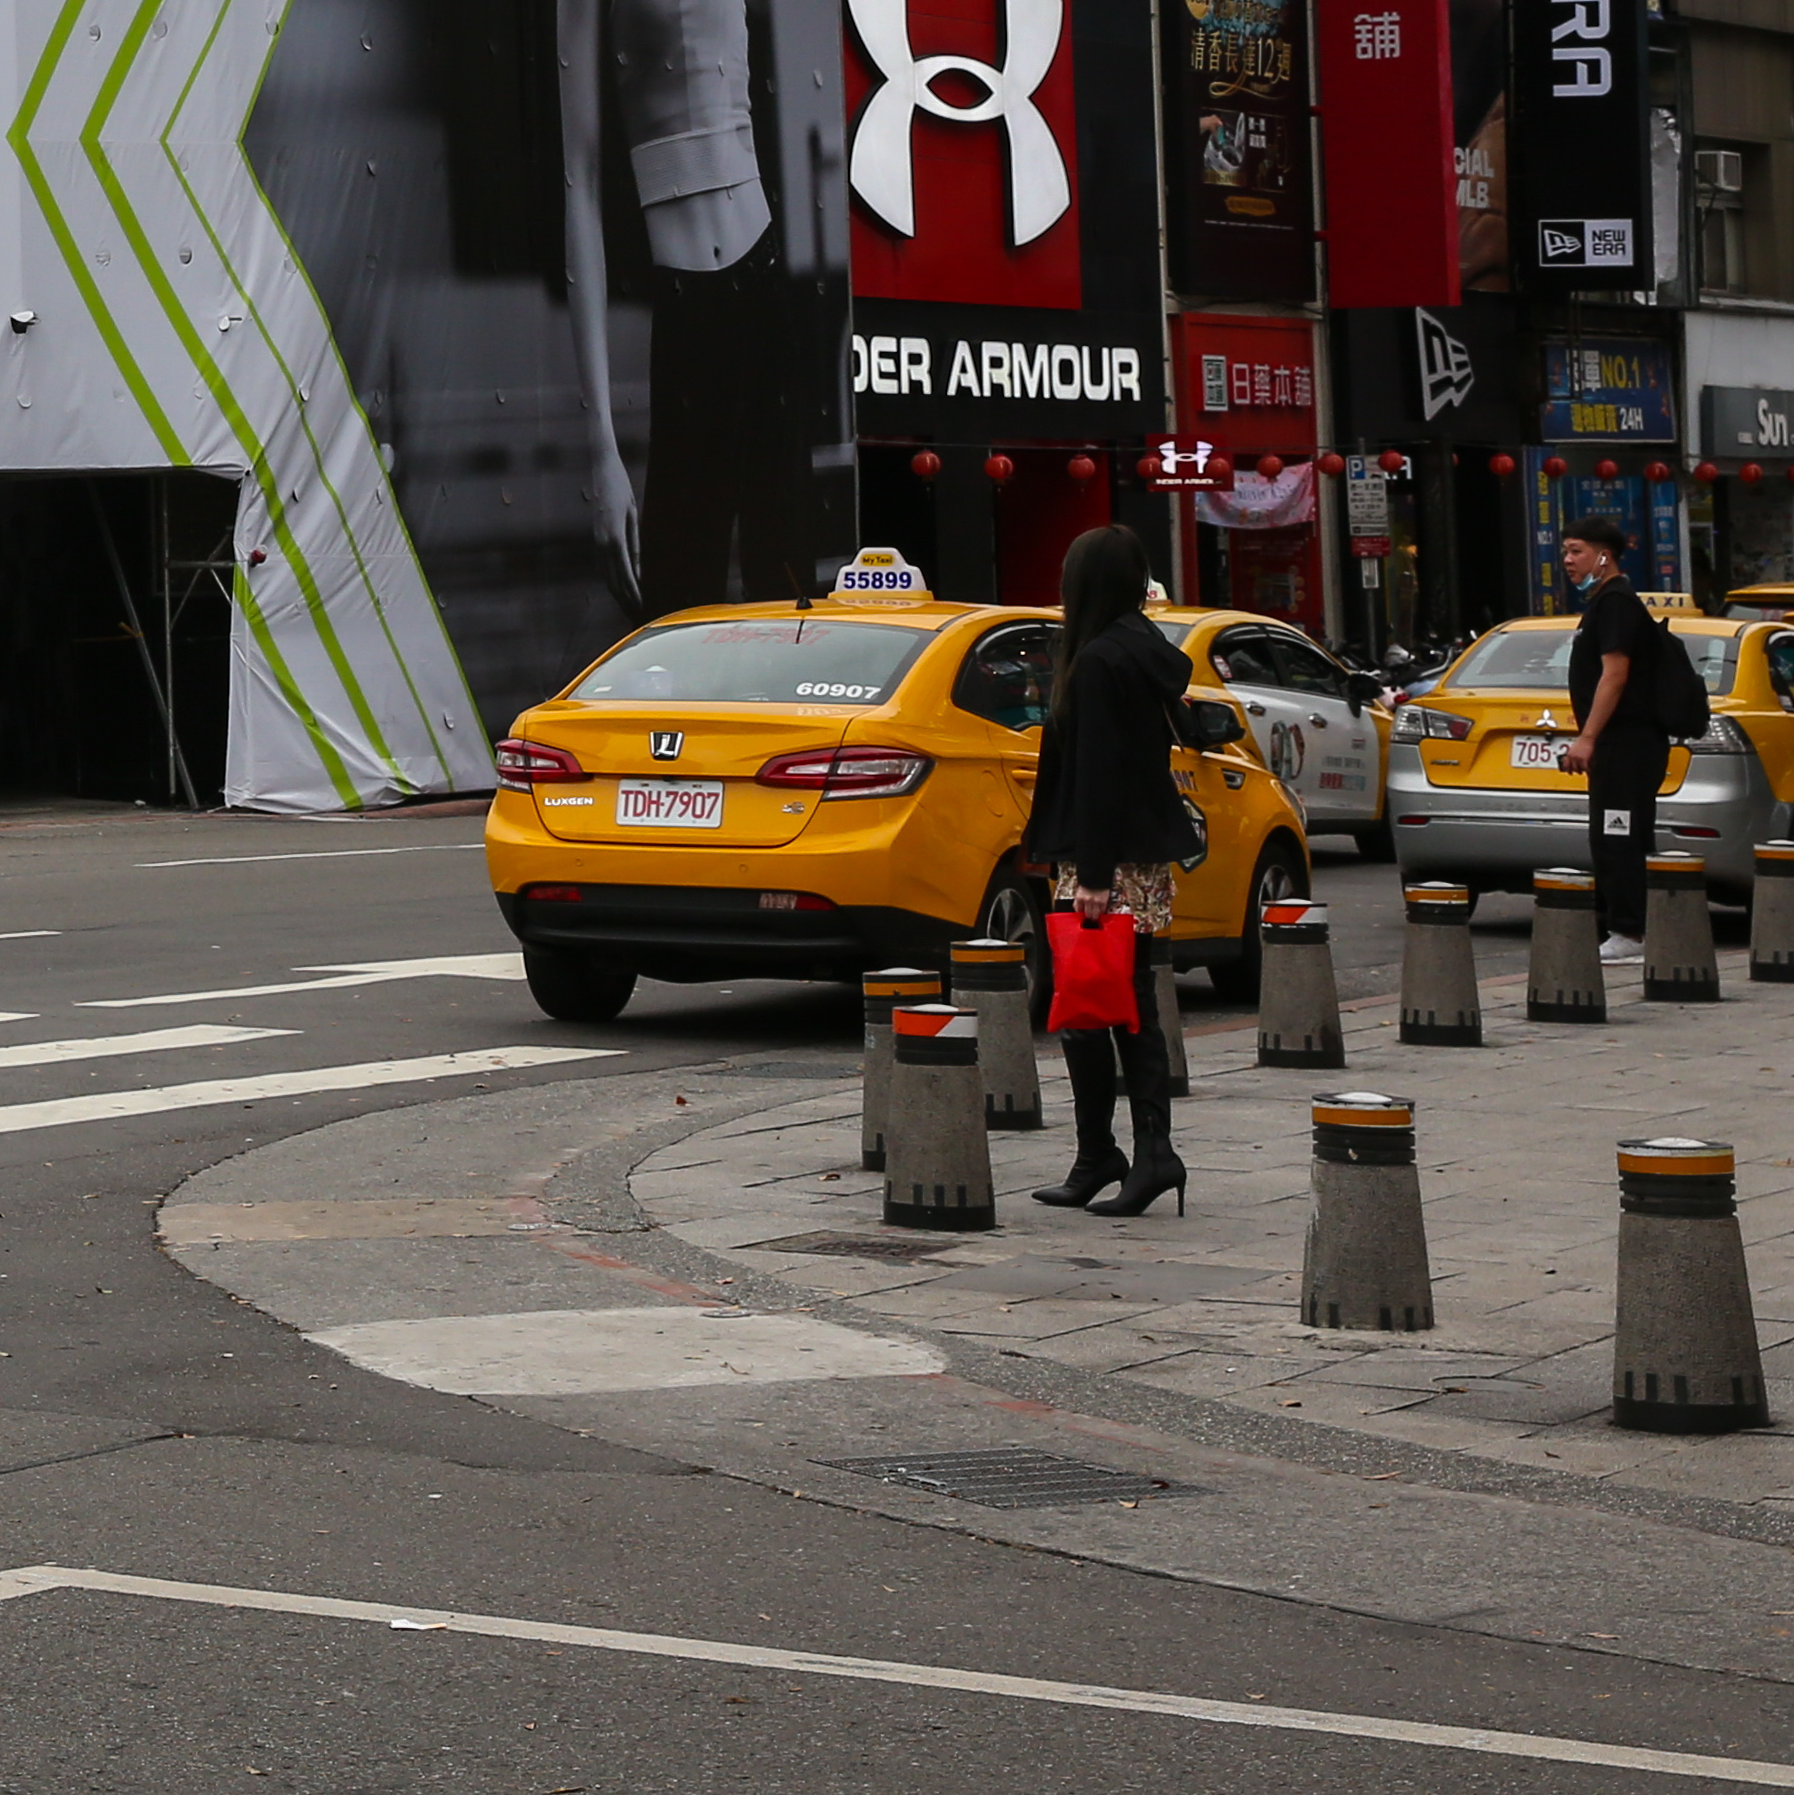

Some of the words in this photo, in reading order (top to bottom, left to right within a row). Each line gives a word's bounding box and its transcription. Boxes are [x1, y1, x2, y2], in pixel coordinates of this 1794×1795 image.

[1592, 229, 1626, 242] NEW
[1592, 242, 1626, 256] ERA
[947, 340, 1141, 401] ARMOUR
[1602, 356, 1640, 389] NO.1
[1619, 407, 1644, 430] 24H
[843, 571, 912, 589] 55899
[1645, 597, 1684, 607] AXI
[795, 682, 881, 700] 60907
[544, 796, 594, 806] LUXGEN
[621, 790, 721, 819] TDH-7907
